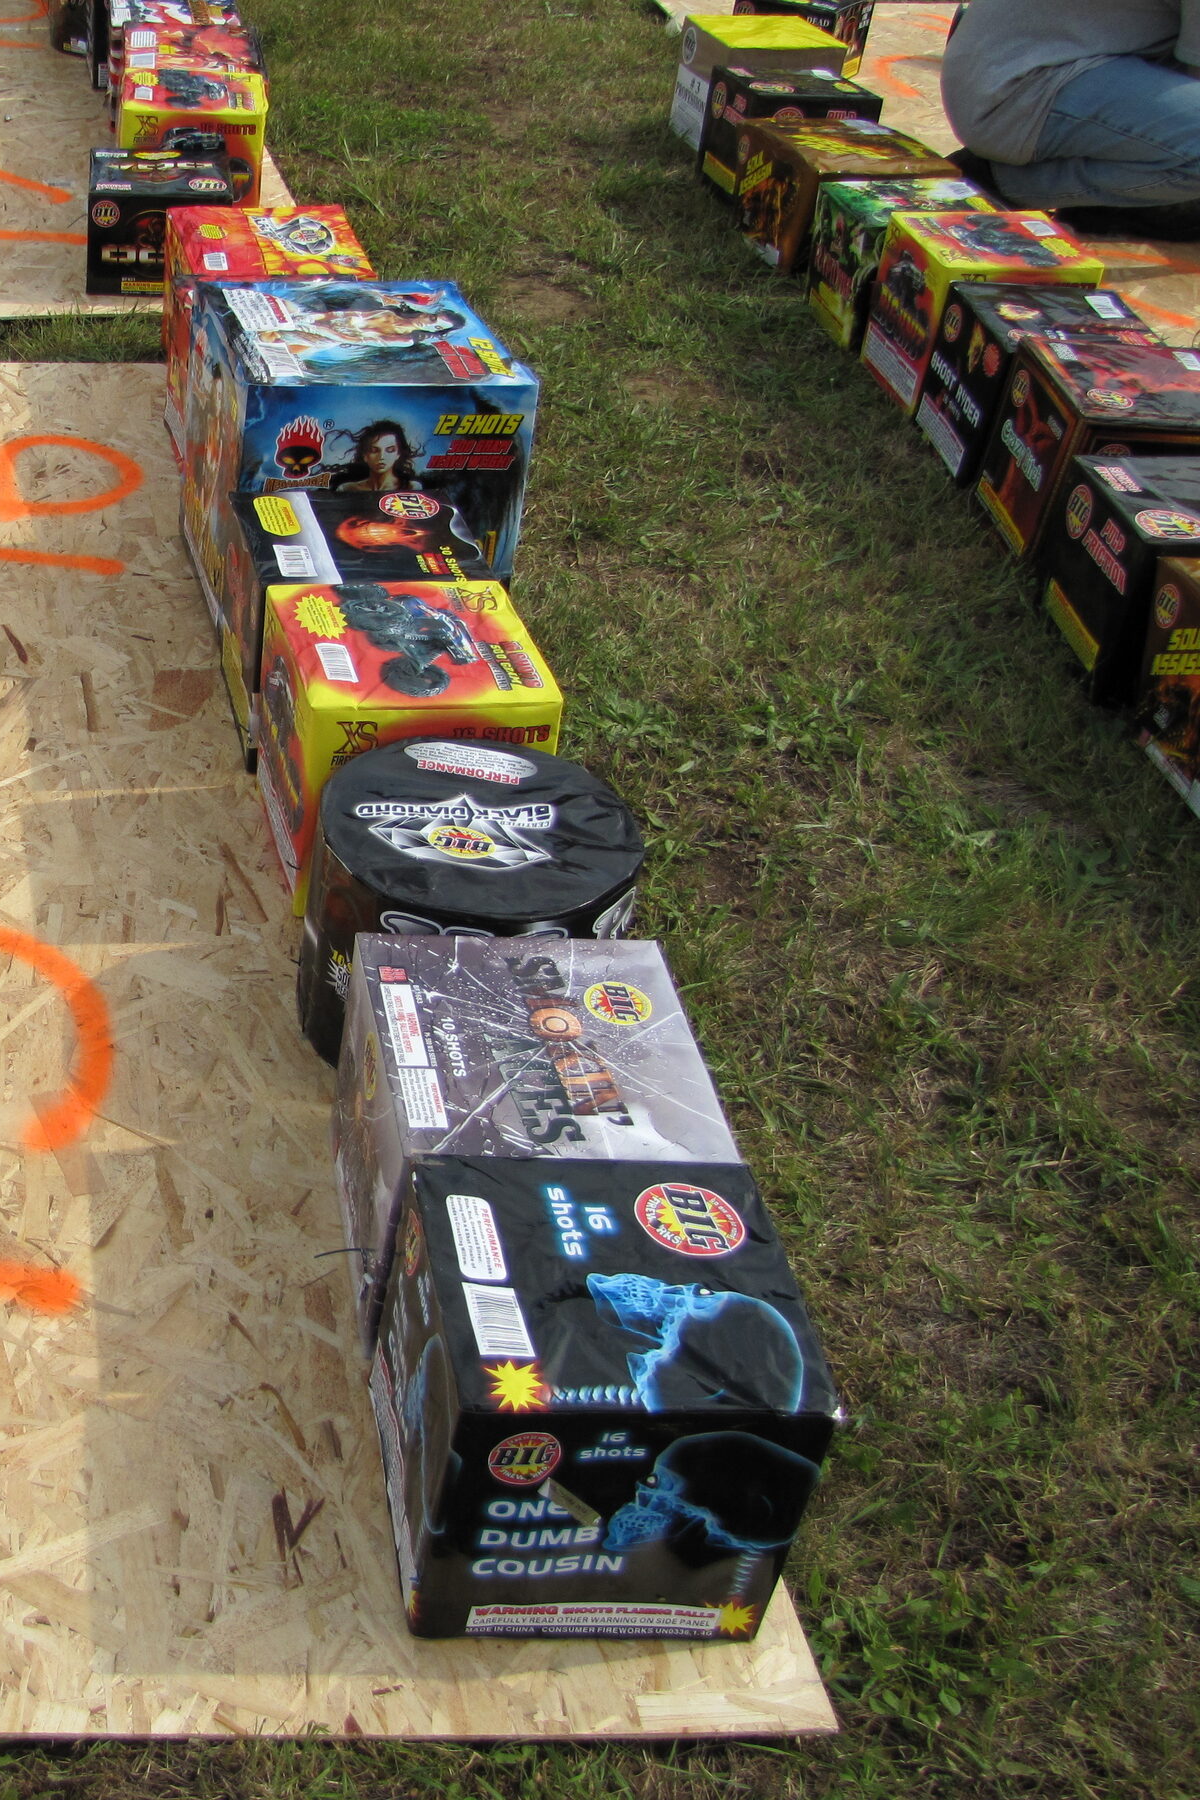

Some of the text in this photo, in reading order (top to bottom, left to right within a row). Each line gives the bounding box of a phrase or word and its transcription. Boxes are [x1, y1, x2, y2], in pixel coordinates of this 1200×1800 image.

[930, 350, 957, 391] GHOST
[955, 383, 980, 429] RYDER
[432, 413, 524, 435] 12 SHOTS
[397, 493, 428, 519] BIG
[1068, 493, 1091, 524] BIG
[1100, 517, 1126, 556] PULP
[439, 545, 453, 556] 30
[1081, 527, 1128, 596] FRICTION
[457, 586, 498, 613] XS
[1157, 593, 1177, 616] BIG
[1167, 628, 1200, 651] SOU
[489, 644, 523, 685] 500 GRAM
[507, 652, 544, 689] SHOTS
[334, 720, 379, 755] XS
[479, 724, 551, 745] SHOTS
[416, 758, 521, 785] PERFORMANCE
[357, 803, 552, 822] BLACK DIAMOND
[500, 820, 551, 828] CERTIFIED
[434, 835, 493, 852] BIG
[602, 983, 641, 1022] BIG
[405, 1012, 421, 1037] WARNING
[440, 1016, 467, 1078] 10 SHOTS
[504, 956, 634, 1126] SMOKIN'
[431, 1082, 443, 1114] PERFORMANCE
[546, 1186, 585, 1257] shots
[584, 1206, 614, 1231] 16
[660, 1185, 732, 1252] BIG
[480, 1207, 503, 1269] PERFORMANCE
[601, 1432, 628, 1443] 16
[490, 1442, 558, 1468] BIG
[579, 1447, 646, 1460] shots
[479, 1525, 601, 1549] DUMB
[471, 1554, 625, 1577] COUSIN
[472, 1616, 711, 1627] CAREFULLY READ OTHER WARNING ON SIDE PANEL
[474, 1605, 717, 1619] WARNING SHOOTS FLAMING BALLS
[541, 1626, 597, 1634] CONSUMER
